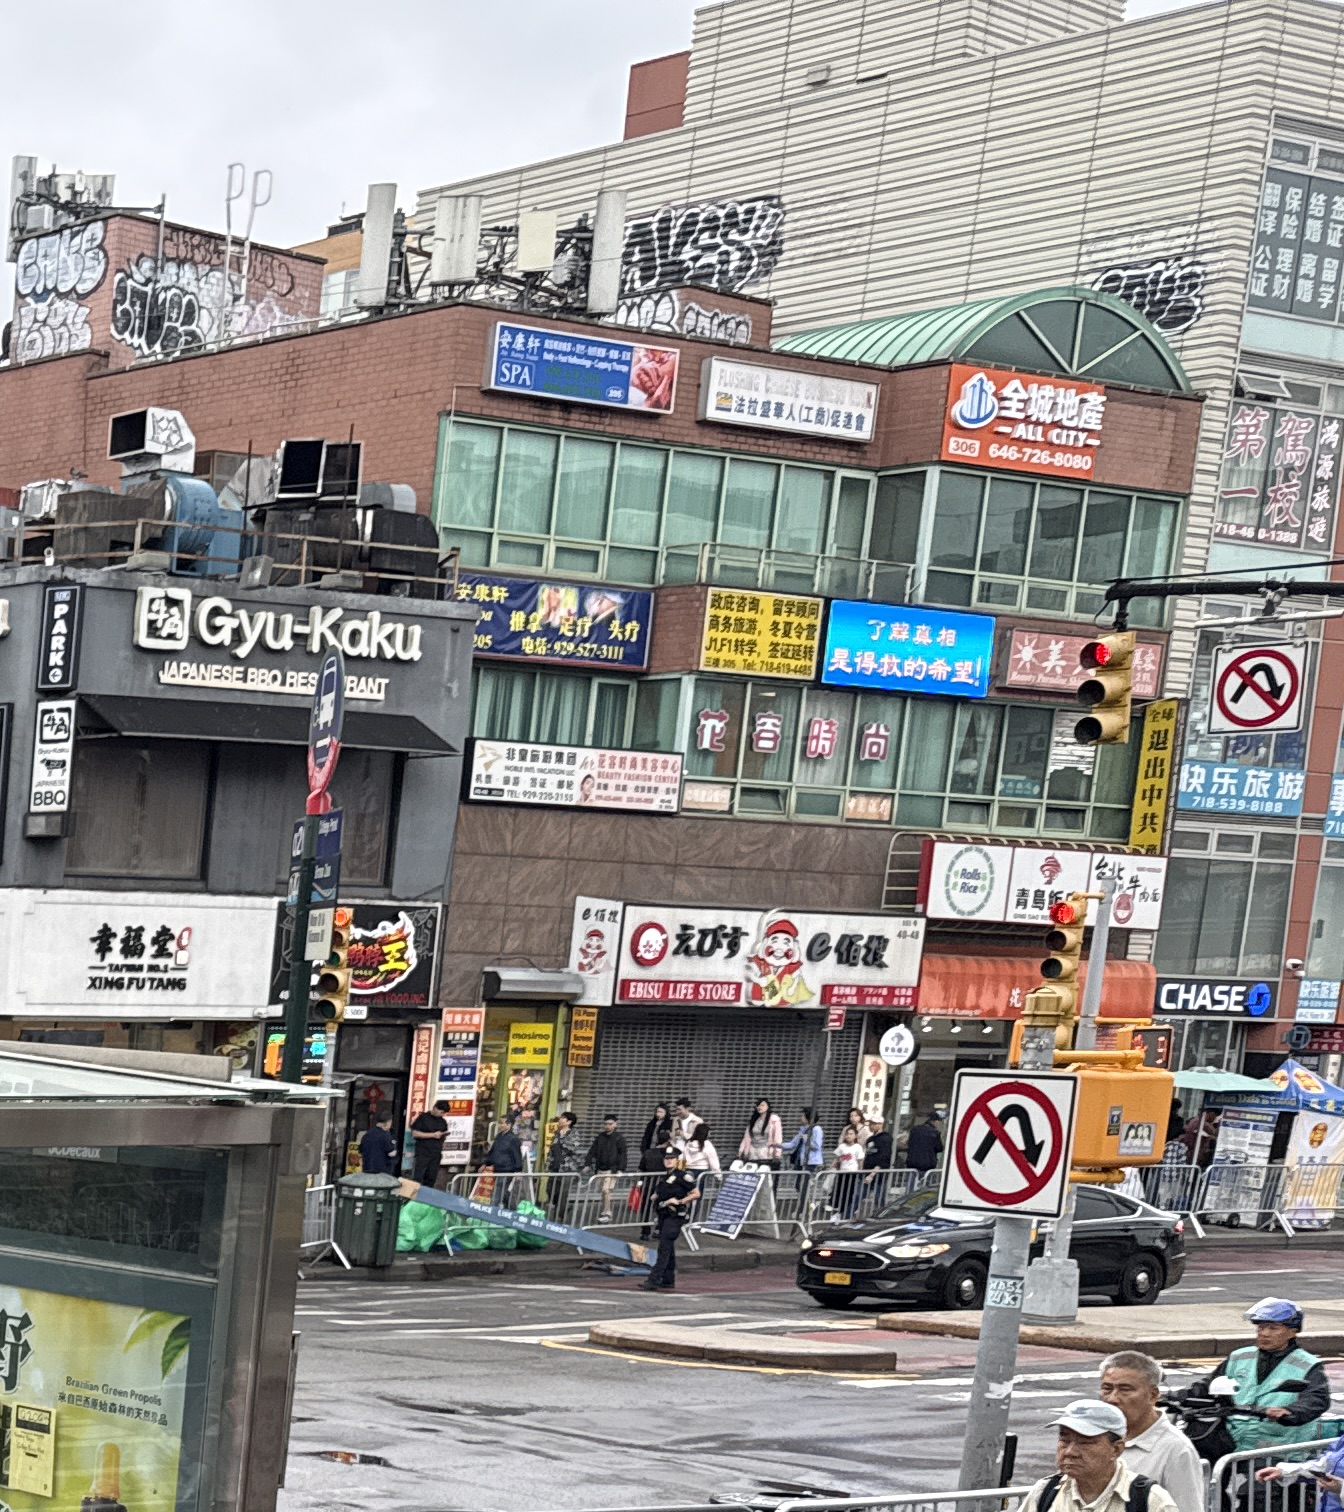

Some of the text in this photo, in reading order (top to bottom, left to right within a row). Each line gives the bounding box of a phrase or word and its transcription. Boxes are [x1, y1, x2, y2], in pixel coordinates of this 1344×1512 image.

[500, 362, 532, 387] SPA
[998, 378, 1107, 430] 全城地產
[952, 439, 977, 454] 306
[1014, 423, 1088, 447] ALL CITY
[988, 443, 1092, 470] 646-726-8080
[49, 604, 69, 667] PARK
[195, 596, 422, 660] Gyu-Kaku
[866, 619, 958, 648] 了解真相
[159, 659, 244, 686] JAPANESE
[246, 666, 282, 688] BBQ
[827, 647, 983, 688] 是得救的希望!
[1138, 729, 1170, 834] 退出中共
[1179, 765, 1306, 801] 快乐旅游
[33, 791, 67, 807] BBQ
[1191, 796, 1284, 813] 718-539-8188
[959, 881, 979, 894] Rice
[960, 868, 982, 881] Rolls
[671, 923, 750, 959] えびす
[86, 976, 188, 991] XING FU TANG
[628, 981, 737, 1000] EBISU LIFE STORE
[1159, 982, 1248, 1012] CHASE
[101, 1382, 129, 1399] Green
[129, 1389, 162, 1407] Propolis
